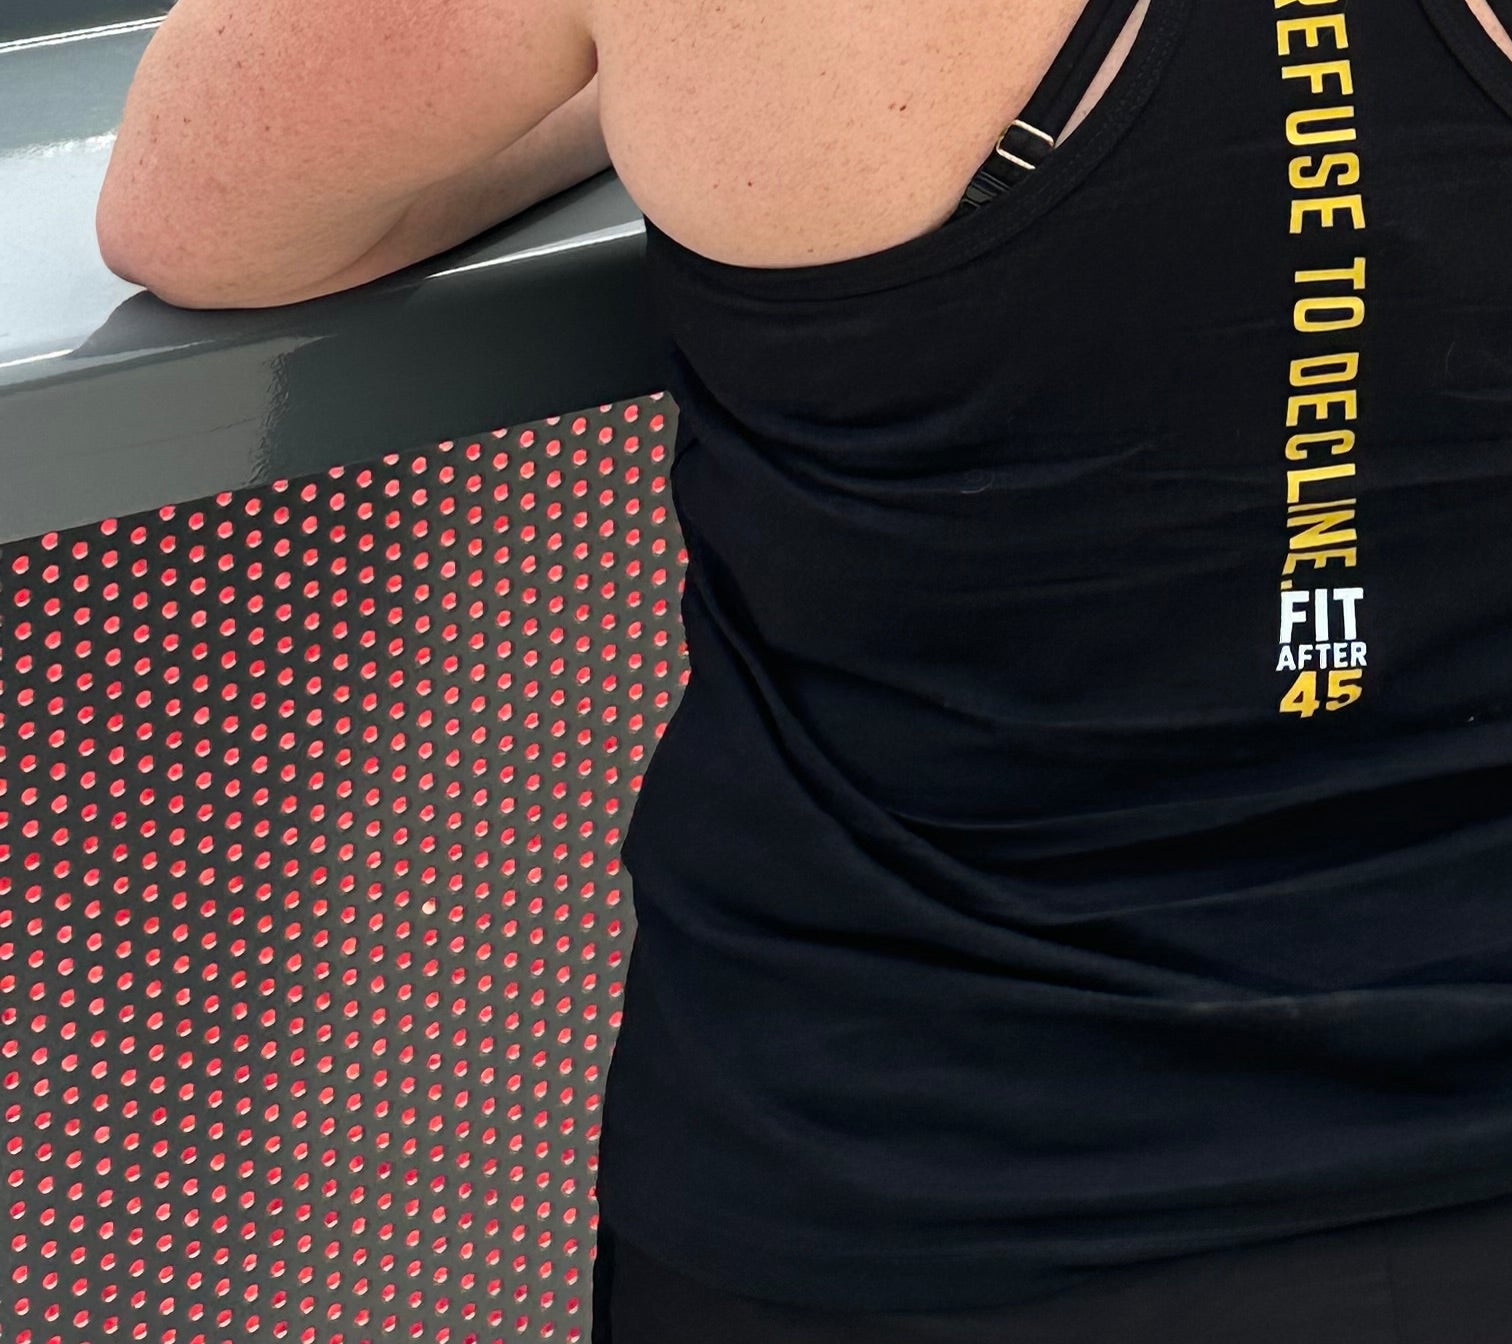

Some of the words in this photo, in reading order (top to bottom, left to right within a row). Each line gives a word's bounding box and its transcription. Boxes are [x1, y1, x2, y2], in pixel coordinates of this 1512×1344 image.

[1293, 256, 1366, 333] TO
[1280, 352, 1359, 590] DECLINE.
[1279, 587, 1364, 645] FIT
[1275, 642, 1368, 672] AFTER
[1279, 668, 1363, 719] 45
